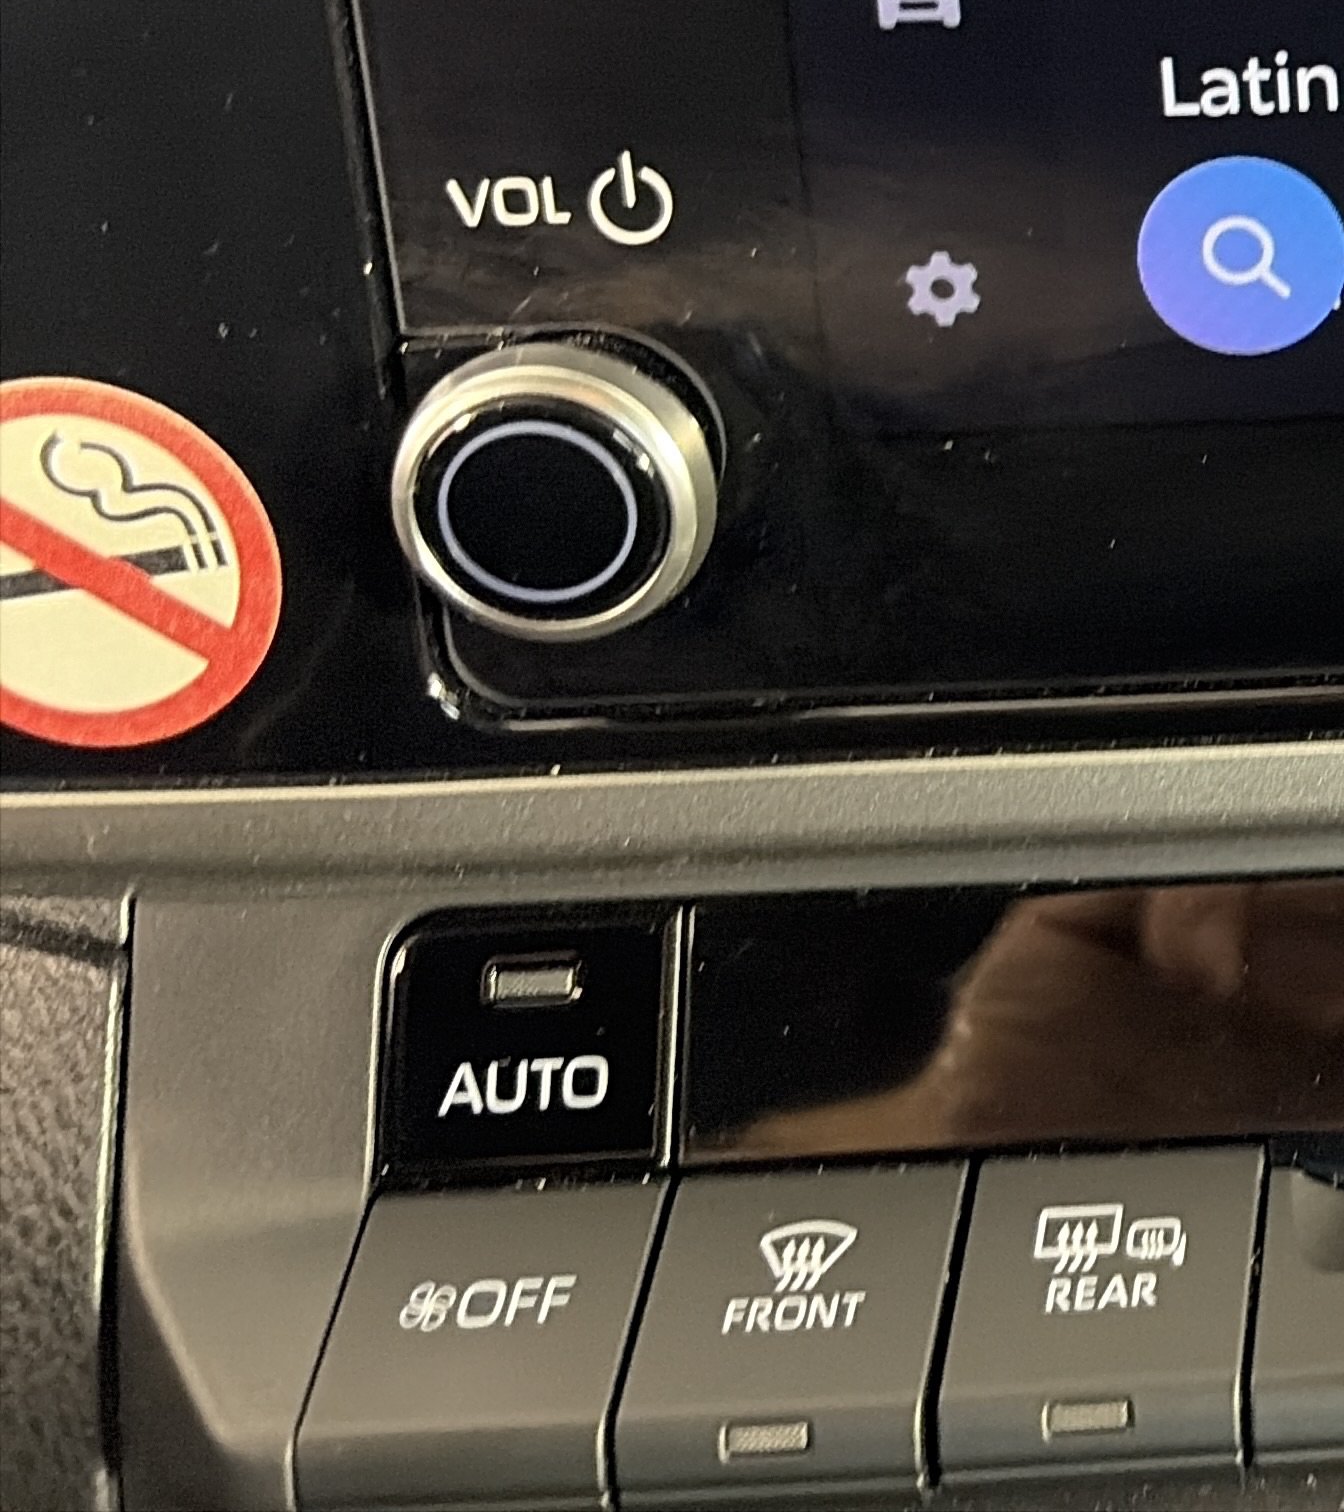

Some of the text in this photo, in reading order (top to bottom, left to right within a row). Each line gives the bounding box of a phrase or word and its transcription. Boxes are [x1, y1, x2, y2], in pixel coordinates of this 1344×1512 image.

[1161, 49, 1340, 118] Latin
[446, 175, 572, 228] VOL
[438, 1054, 610, 1117] AUTO
[456, 1273, 577, 1331] OFF
[721, 1290, 867, 1334] FRONT
[1043, 1270, 1159, 1313] REAR
